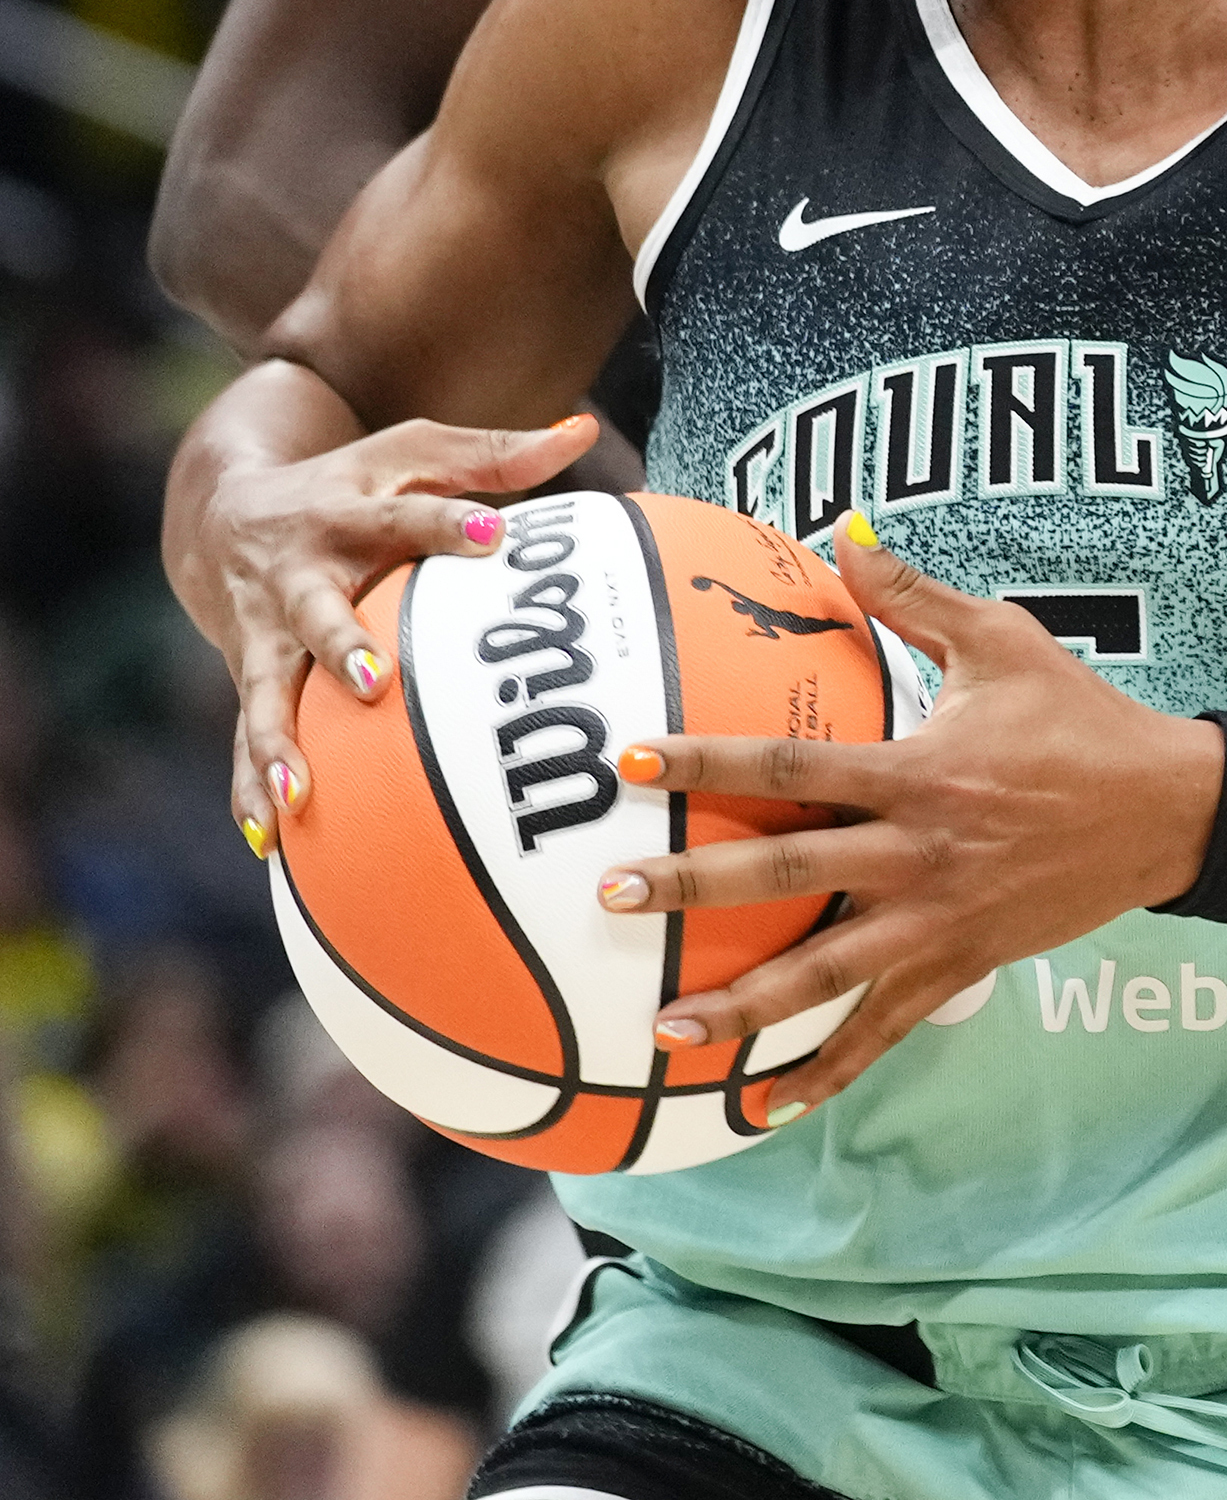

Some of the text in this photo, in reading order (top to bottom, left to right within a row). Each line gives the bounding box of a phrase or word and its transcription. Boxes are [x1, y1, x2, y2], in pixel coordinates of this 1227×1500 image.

[611, 617, 630, 658] EVO
[475, 501, 619, 857] Wilson
[805, 672, 818, 731] BALL
